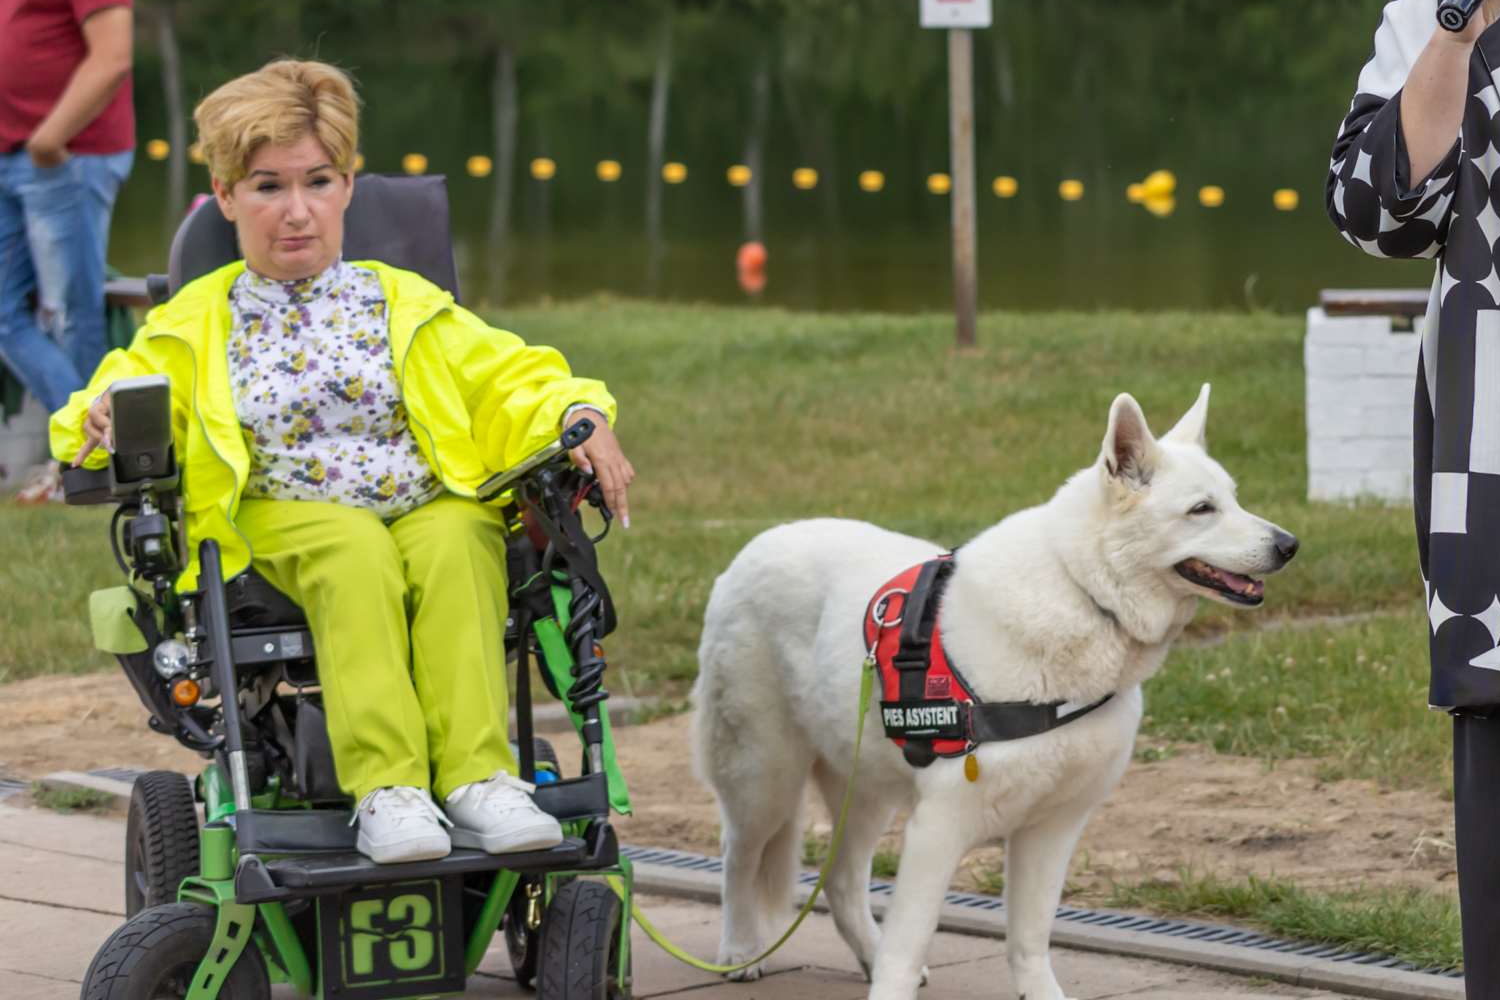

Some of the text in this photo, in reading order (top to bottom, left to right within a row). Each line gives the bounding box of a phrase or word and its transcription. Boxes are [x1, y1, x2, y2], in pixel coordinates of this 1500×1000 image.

[883, 706, 958, 727] PIES ASYSTENT
[351, 894, 434, 974] F3
